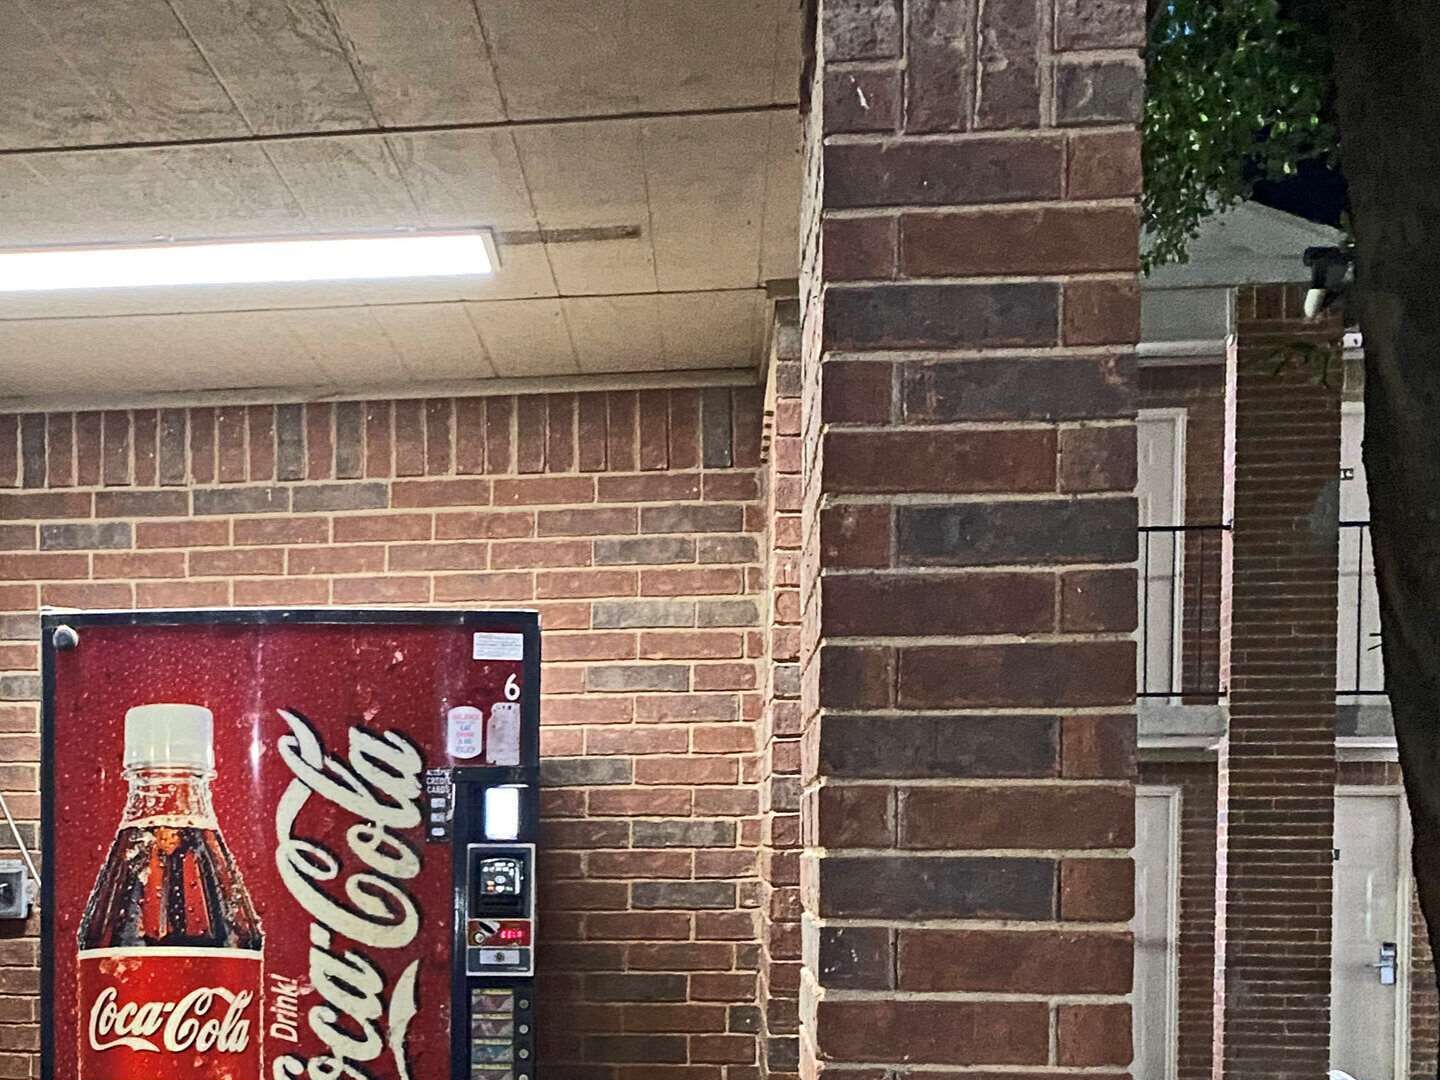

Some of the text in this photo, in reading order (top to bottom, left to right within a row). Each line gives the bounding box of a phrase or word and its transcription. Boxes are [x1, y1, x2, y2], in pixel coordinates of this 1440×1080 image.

[504, 673, 520, 700] 6
[89, 986, 253, 1052] Coca-Cola
[269, 973, 298, 1043] Drink!
